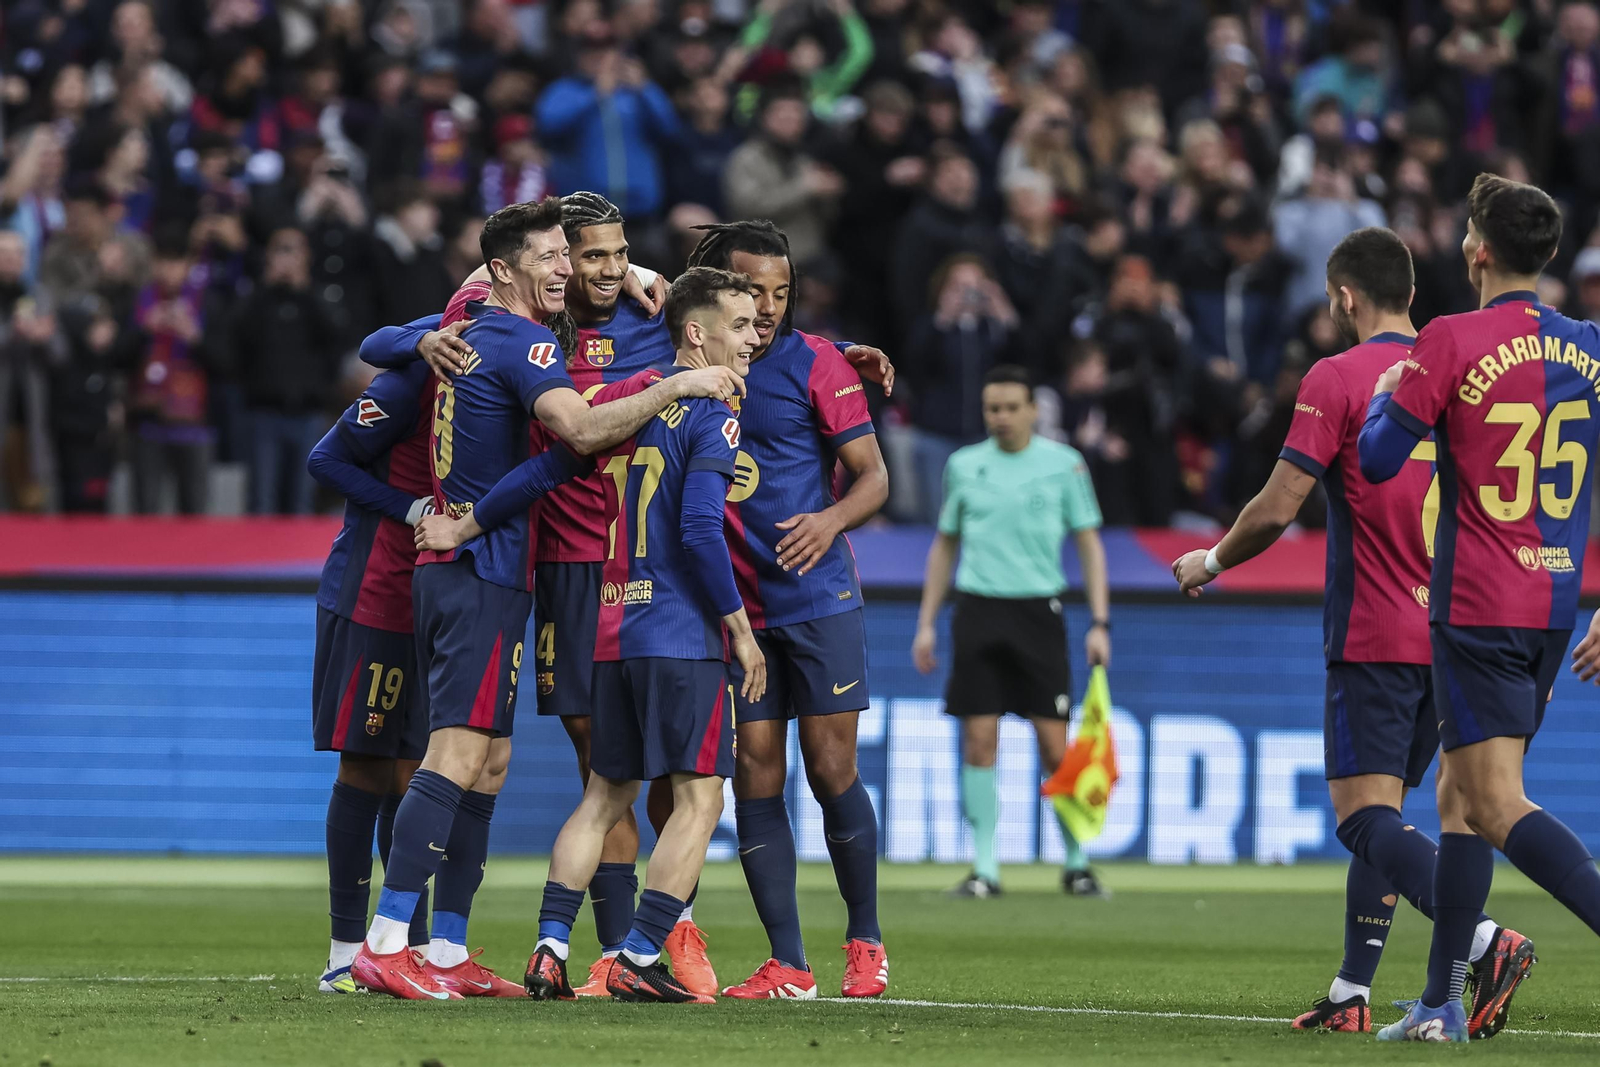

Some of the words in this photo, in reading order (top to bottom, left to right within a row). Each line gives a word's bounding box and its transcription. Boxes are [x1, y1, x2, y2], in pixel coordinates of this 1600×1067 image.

[1458, 334, 1543, 406] GERARD
[1544, 335, 1600, 403] MART
[1479, 399, 1591, 521] 35
[602, 446, 665, 560] 17
[622, 590, 653, 601] ACNUR
[624, 580, 653, 591] UNHCR
[511, 641, 523, 686] 9
[536, 622, 556, 666] 4
[367, 662, 404, 711] 19
